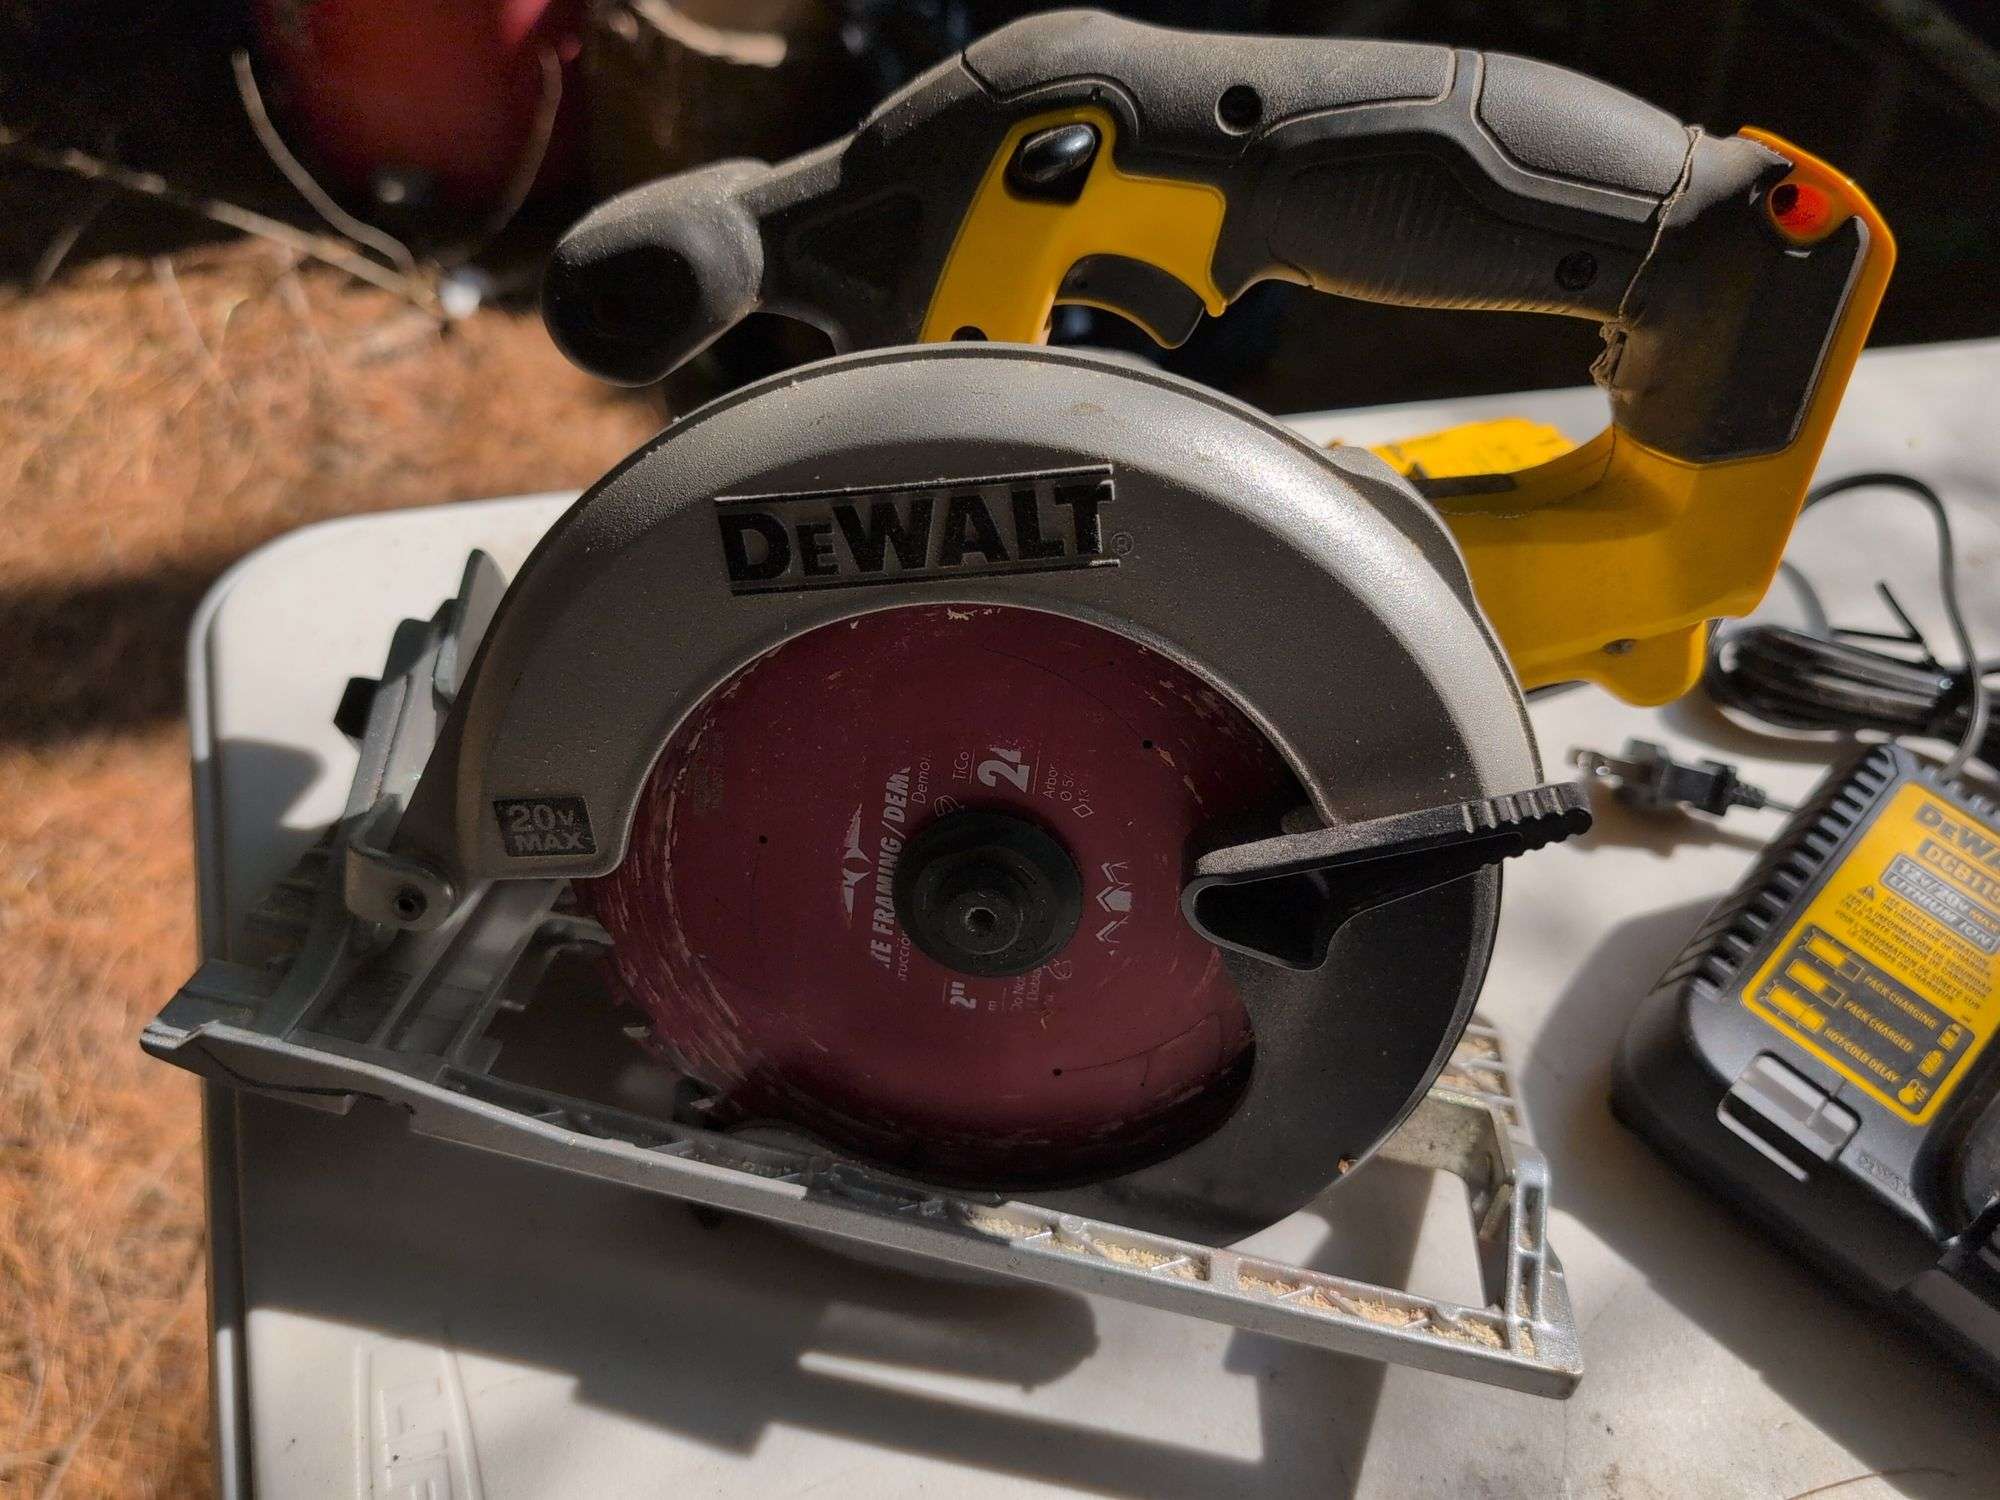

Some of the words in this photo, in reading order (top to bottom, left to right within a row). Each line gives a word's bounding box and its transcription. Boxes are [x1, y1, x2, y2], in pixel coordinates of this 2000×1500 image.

[952, 751, 970, 780] TiCo
[513, 832, 587, 850] MAX
[872, 766, 912, 936] FRAMING/DEM
[1886, 873, 1958, 926] LITHIUM
[1957, 920, 1993, 950] ION
[1864, 975, 1890, 998] PACK
[1843, 1000, 1871, 1024] PACK
